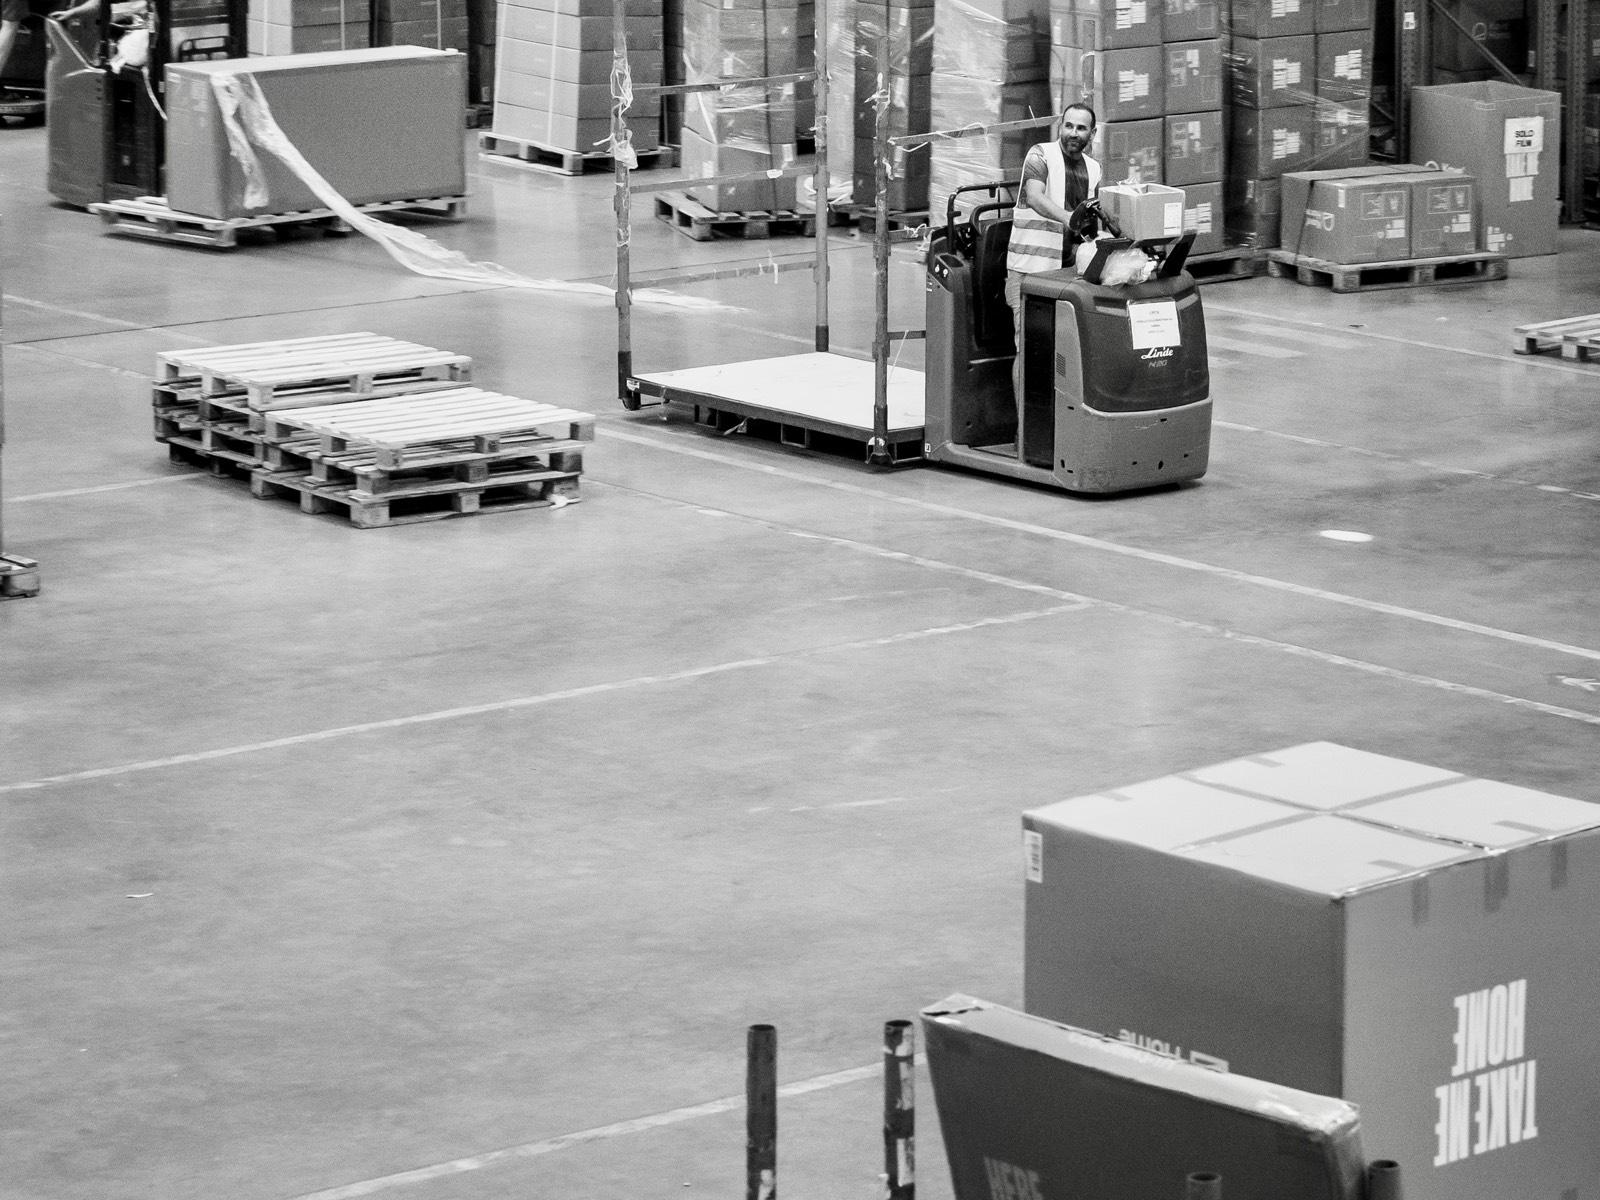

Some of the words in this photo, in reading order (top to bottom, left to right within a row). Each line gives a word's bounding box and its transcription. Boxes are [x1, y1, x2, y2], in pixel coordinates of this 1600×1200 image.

[1140, 346, 1174, 360] Linde
[1451, 978, 1527, 1077] HOME
[1433, 1077, 1471, 1168] ME
[1473, 1059, 1539, 1155] TAKE
